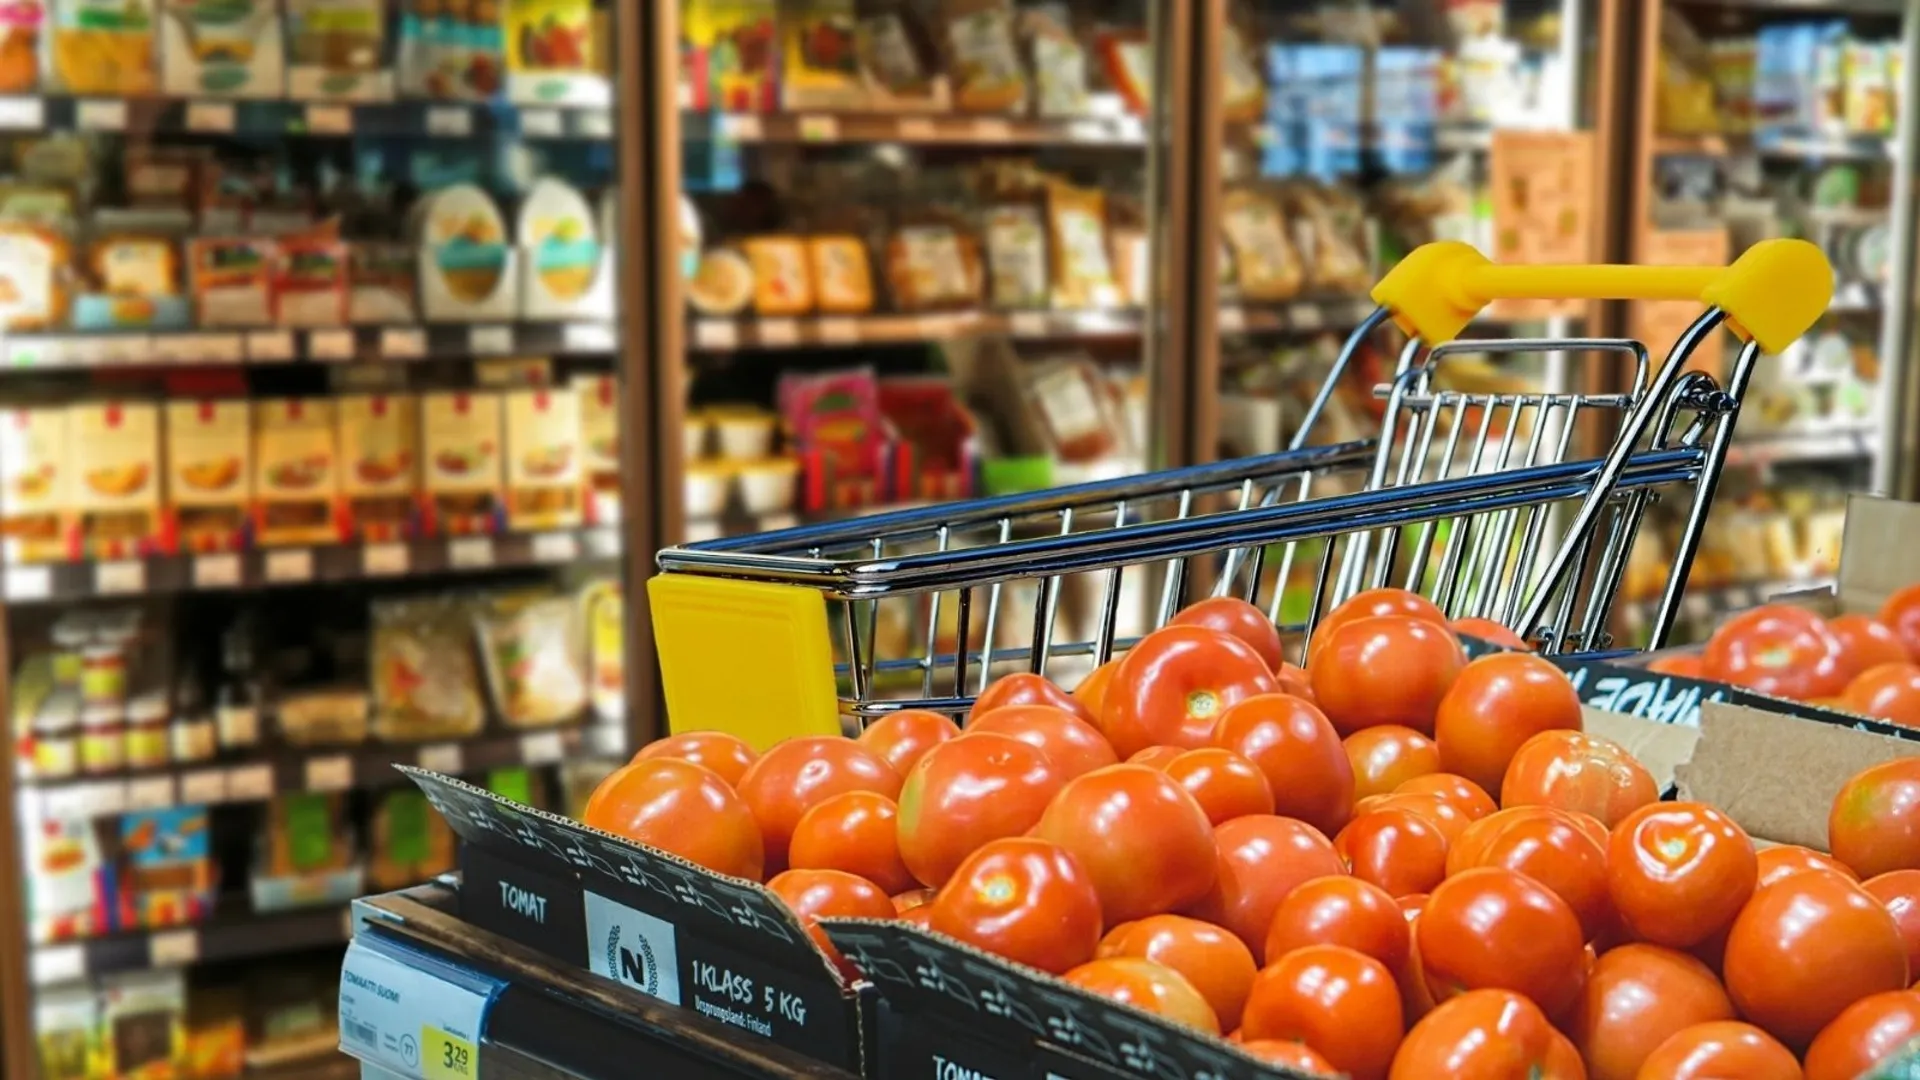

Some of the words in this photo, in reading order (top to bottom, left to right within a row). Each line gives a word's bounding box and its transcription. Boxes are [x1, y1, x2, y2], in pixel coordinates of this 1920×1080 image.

[499, 880, 547, 924] TOMAT
[620, 946, 645, 986] N
[746, 1014, 772, 1037] Finland
[764, 985, 774, 1012] 5
[780, 991, 806, 1026] KG
